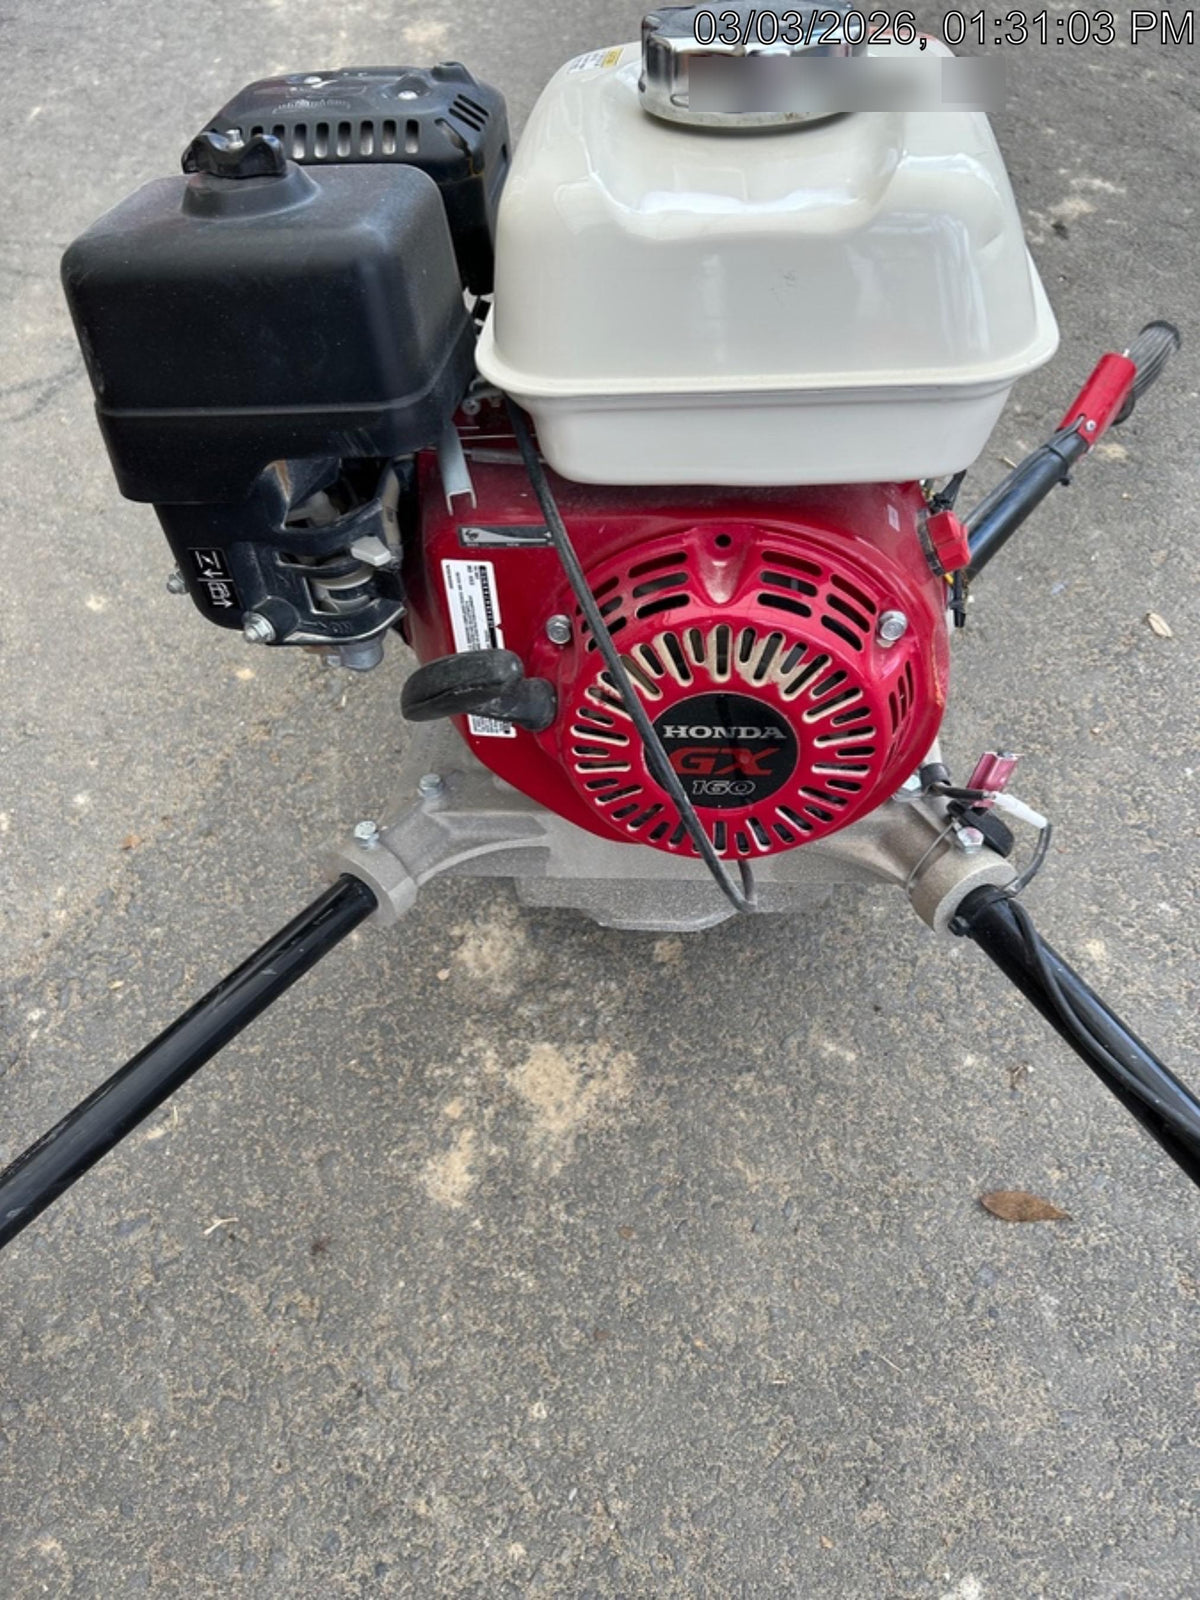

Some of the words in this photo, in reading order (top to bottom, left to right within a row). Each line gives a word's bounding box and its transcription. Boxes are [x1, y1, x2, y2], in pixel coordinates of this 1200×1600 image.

[663, 725, 787, 739] HONDA
[669, 747, 780, 775] GX
[692, 780, 756, 795] 160
